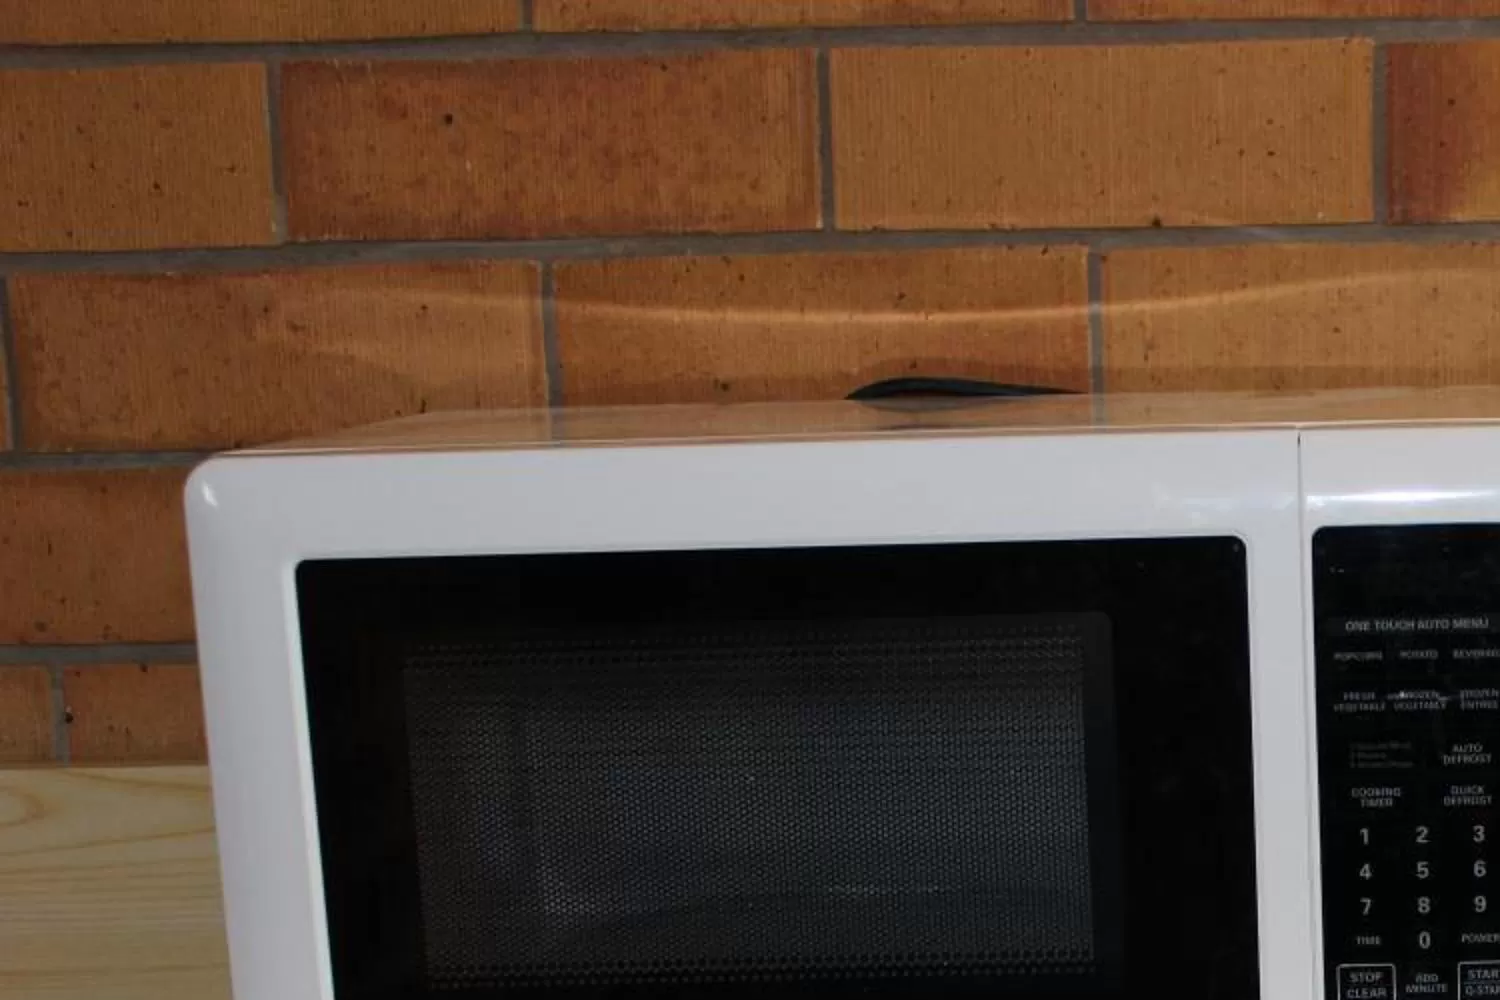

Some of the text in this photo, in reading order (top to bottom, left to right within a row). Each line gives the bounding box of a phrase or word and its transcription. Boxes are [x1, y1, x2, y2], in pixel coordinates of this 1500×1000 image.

[1345, 616, 1489, 631] ONE TOUCH AUTO MENU
[1453, 743, 1483, 753] AUTO
[1443, 753, 1492, 764] DEFROST
[1351, 786, 1402, 797] COOKING
[1450, 785, 1485, 795] QUICK
[1360, 797, 1393, 807] TIMER
[1443, 796, 1492, 806] DEFROST
[1359, 827, 1370, 845] 1
[1415, 826, 1431, 843] 2
[1472, 825, 1485, 842] 3
[1359, 863, 1373, 880] 4
[1415, 861, 1430, 879] 5
[1473, 860, 1487, 877] 6
[1360, 898, 1372, 915] 7
[1417, 896, 1431, 914] 8
[1474, 895, 1487, 912] 9
[1418, 931, 1431, 949] 0
[1461, 933, 1500, 944] POWER
[1349, 971, 1384, 983] STOP
[1415, 973, 1439, 983] ADD
[1346, 986, 1387, 999] CLEAR
[1405, 983, 1448, 993] MINUTE
